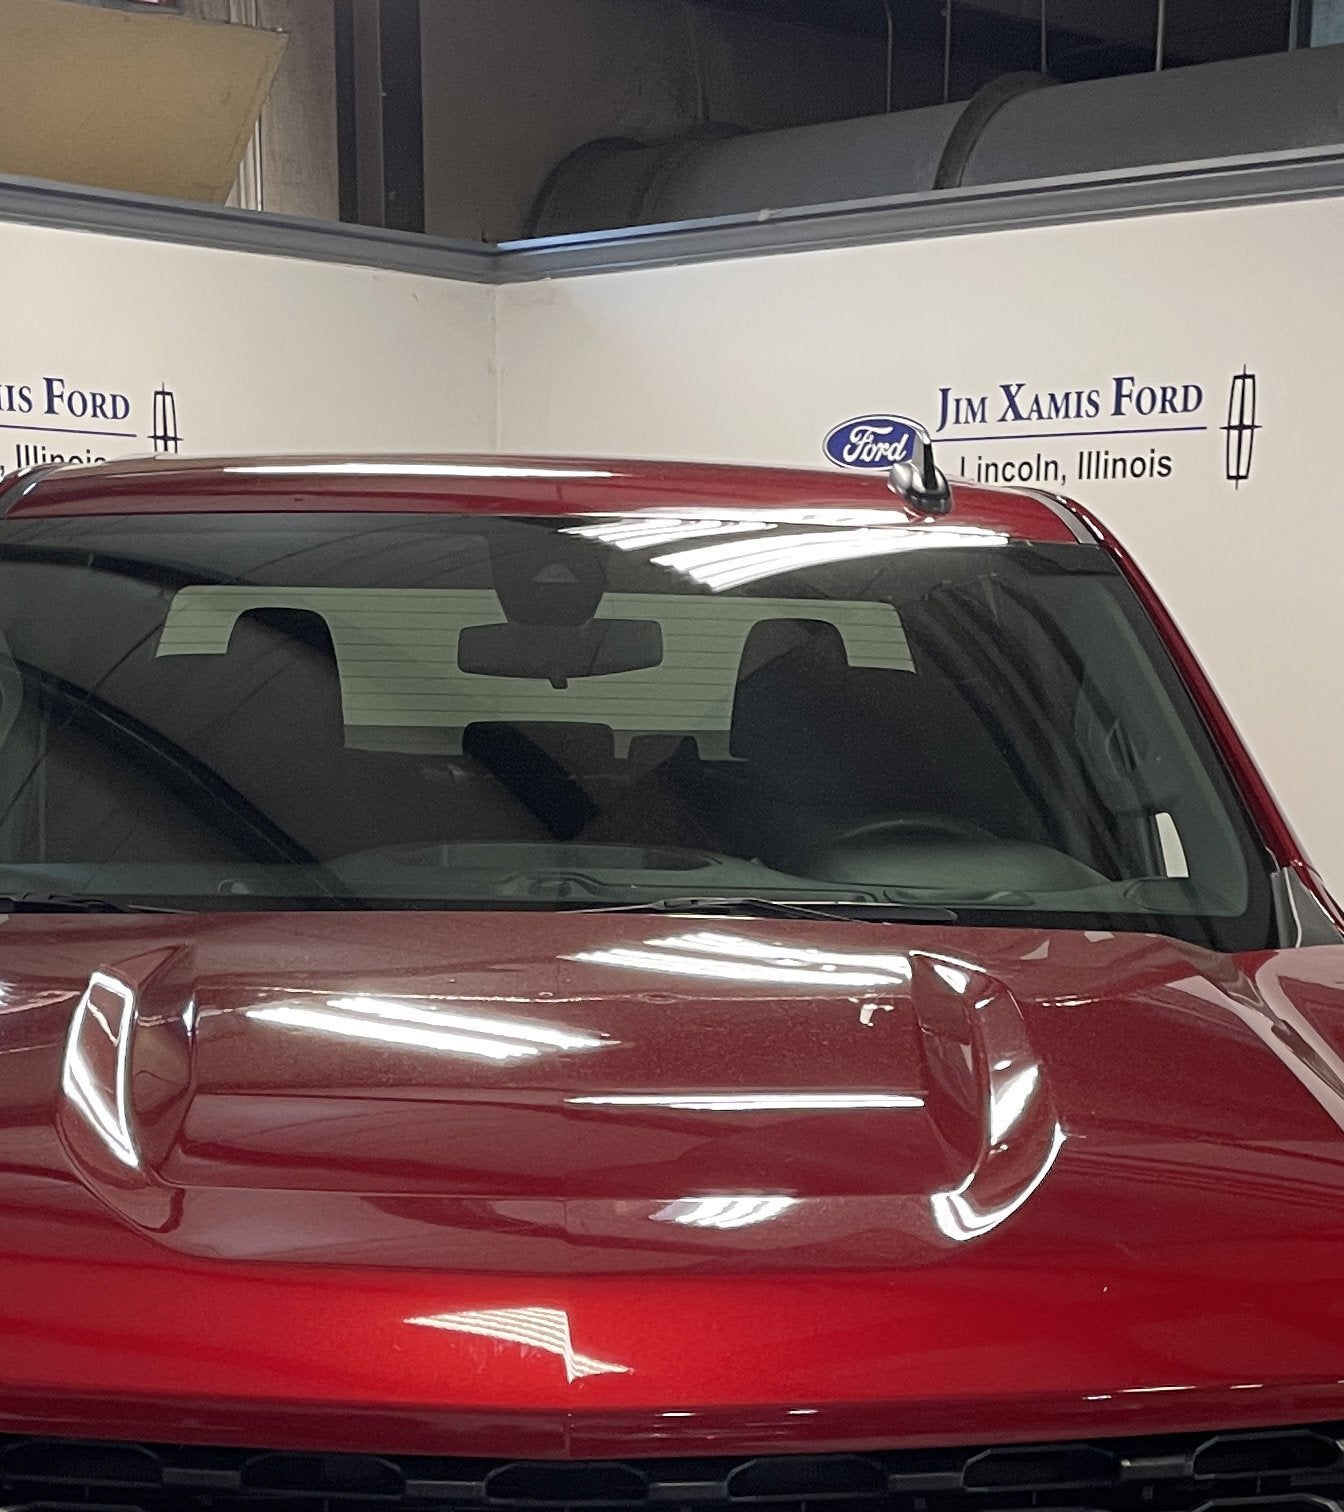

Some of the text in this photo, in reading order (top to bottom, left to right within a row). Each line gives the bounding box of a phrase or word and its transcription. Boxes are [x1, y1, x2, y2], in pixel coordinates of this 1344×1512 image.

[43, 377, 130, 420] FORD
[936, 376, 1203, 433] JIM XAMIS FORD
[843, 425, 909, 462] Ford
[1078, 448, 1172, 480] Illinois
